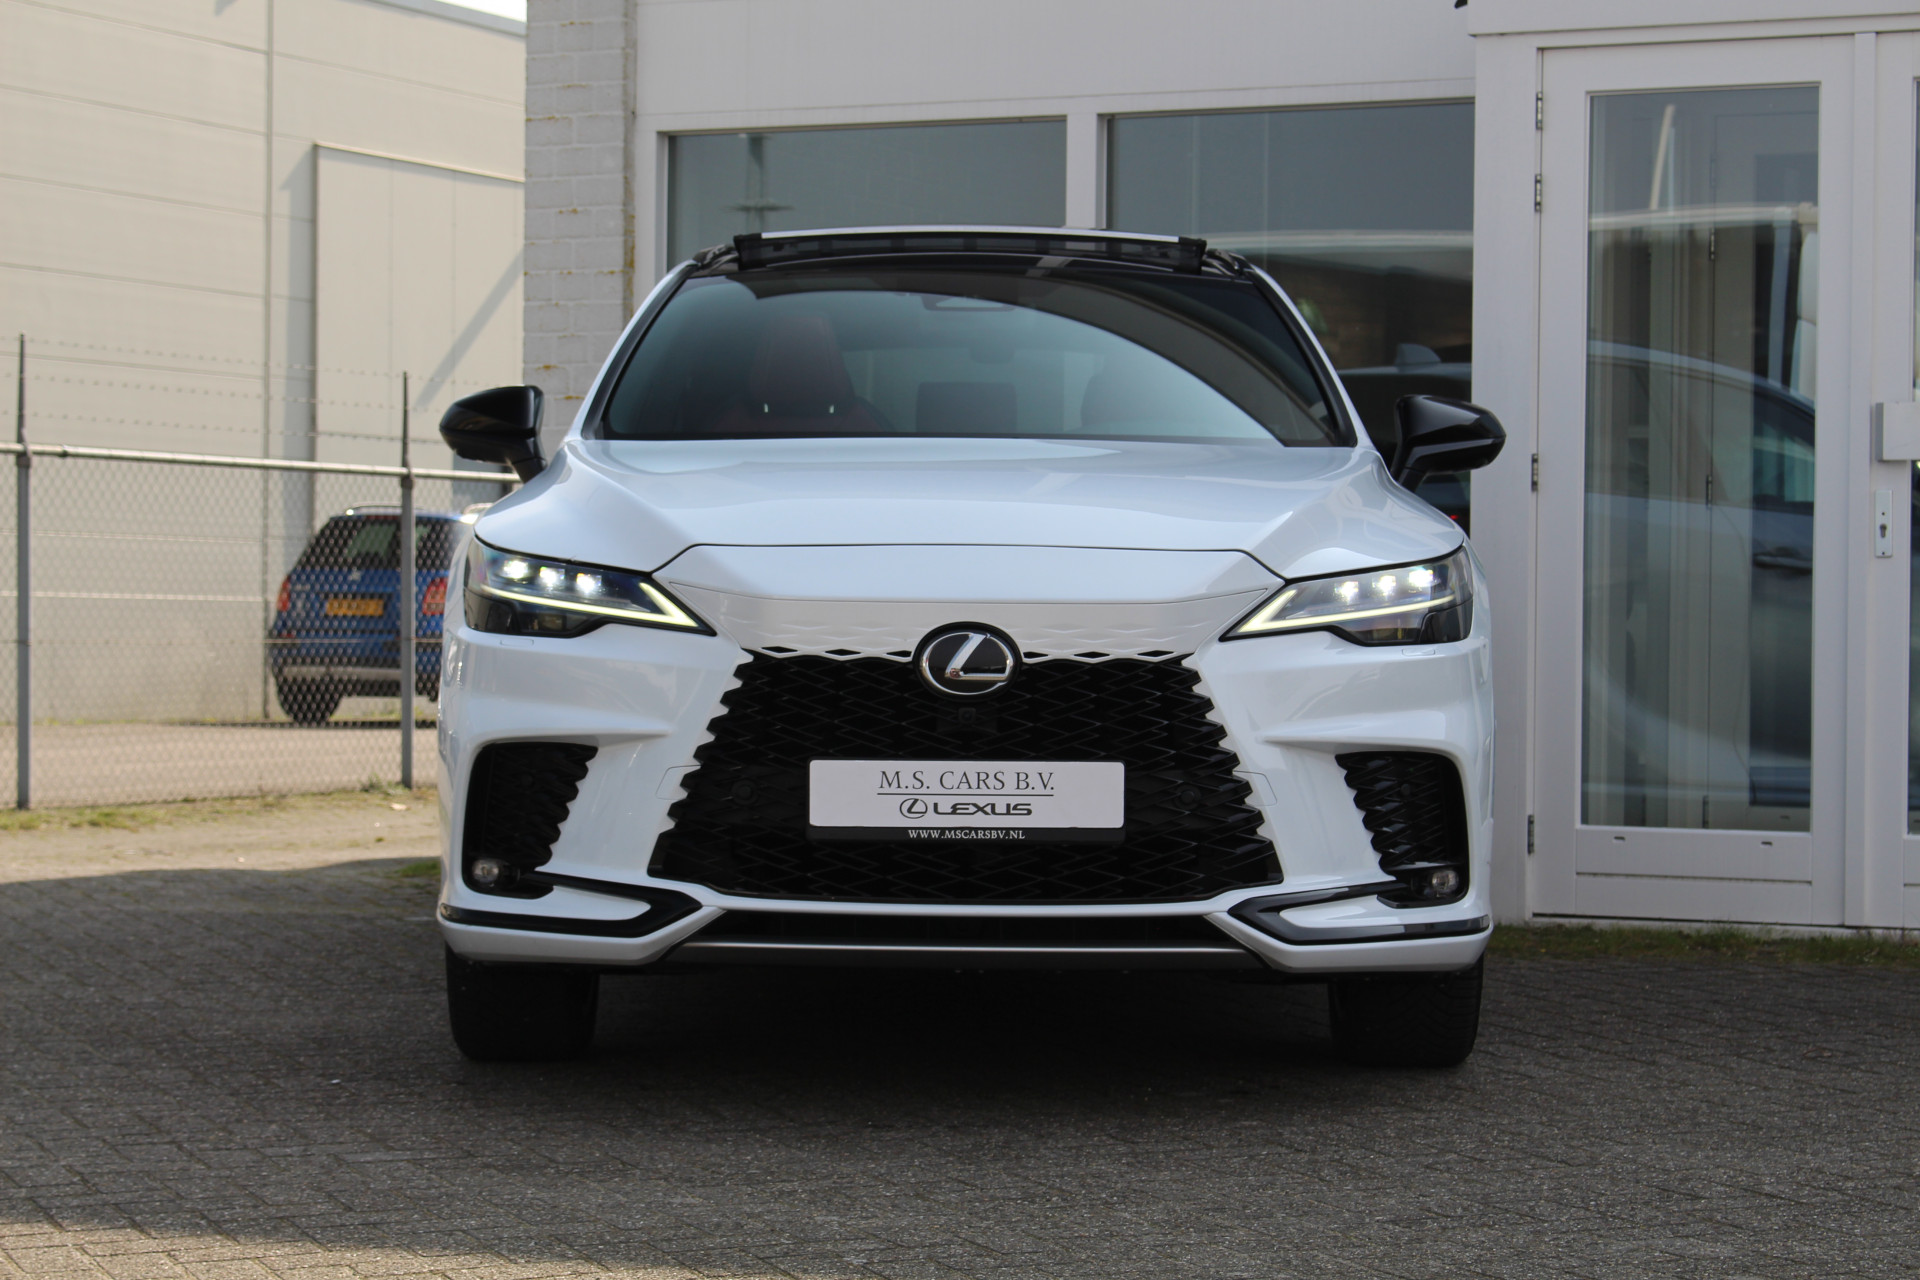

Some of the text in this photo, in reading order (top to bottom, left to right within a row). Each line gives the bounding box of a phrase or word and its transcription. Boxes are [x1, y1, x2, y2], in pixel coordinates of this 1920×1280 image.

[878, 770, 1055, 791] M.S. CARS B.V.
[933, 802, 1033, 816] LEXUS
[907, 829, 1026, 840] WWW.MSCARSBV.NL
